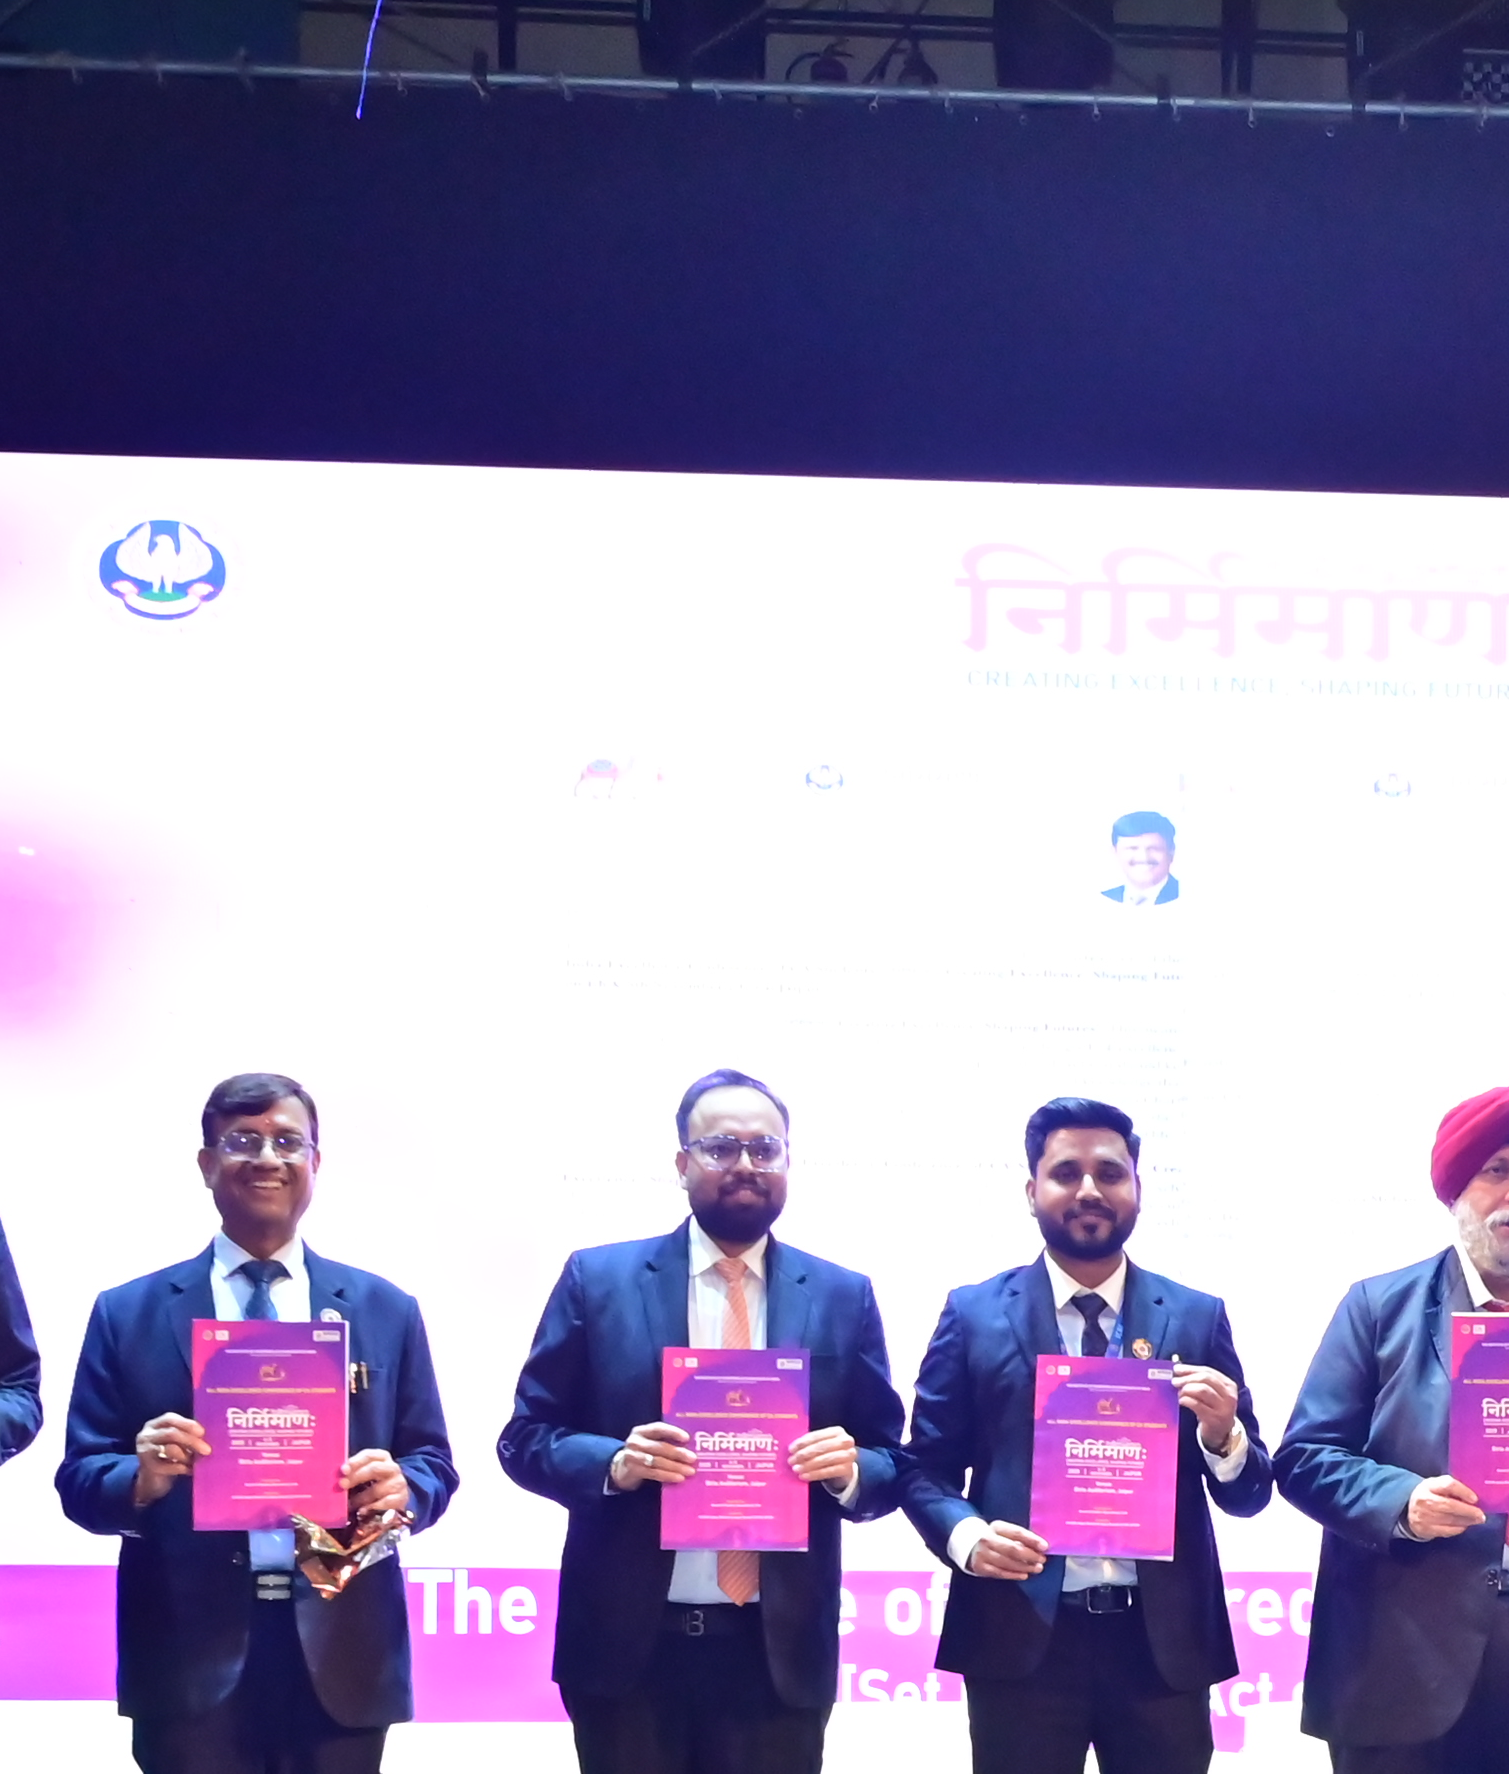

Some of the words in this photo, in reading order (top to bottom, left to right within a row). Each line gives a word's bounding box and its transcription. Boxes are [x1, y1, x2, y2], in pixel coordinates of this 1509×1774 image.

[965, 668, 1099, 690] CREATING
[407, 1569, 538, 1636] The
[884, 1572, 950, 1636] of
